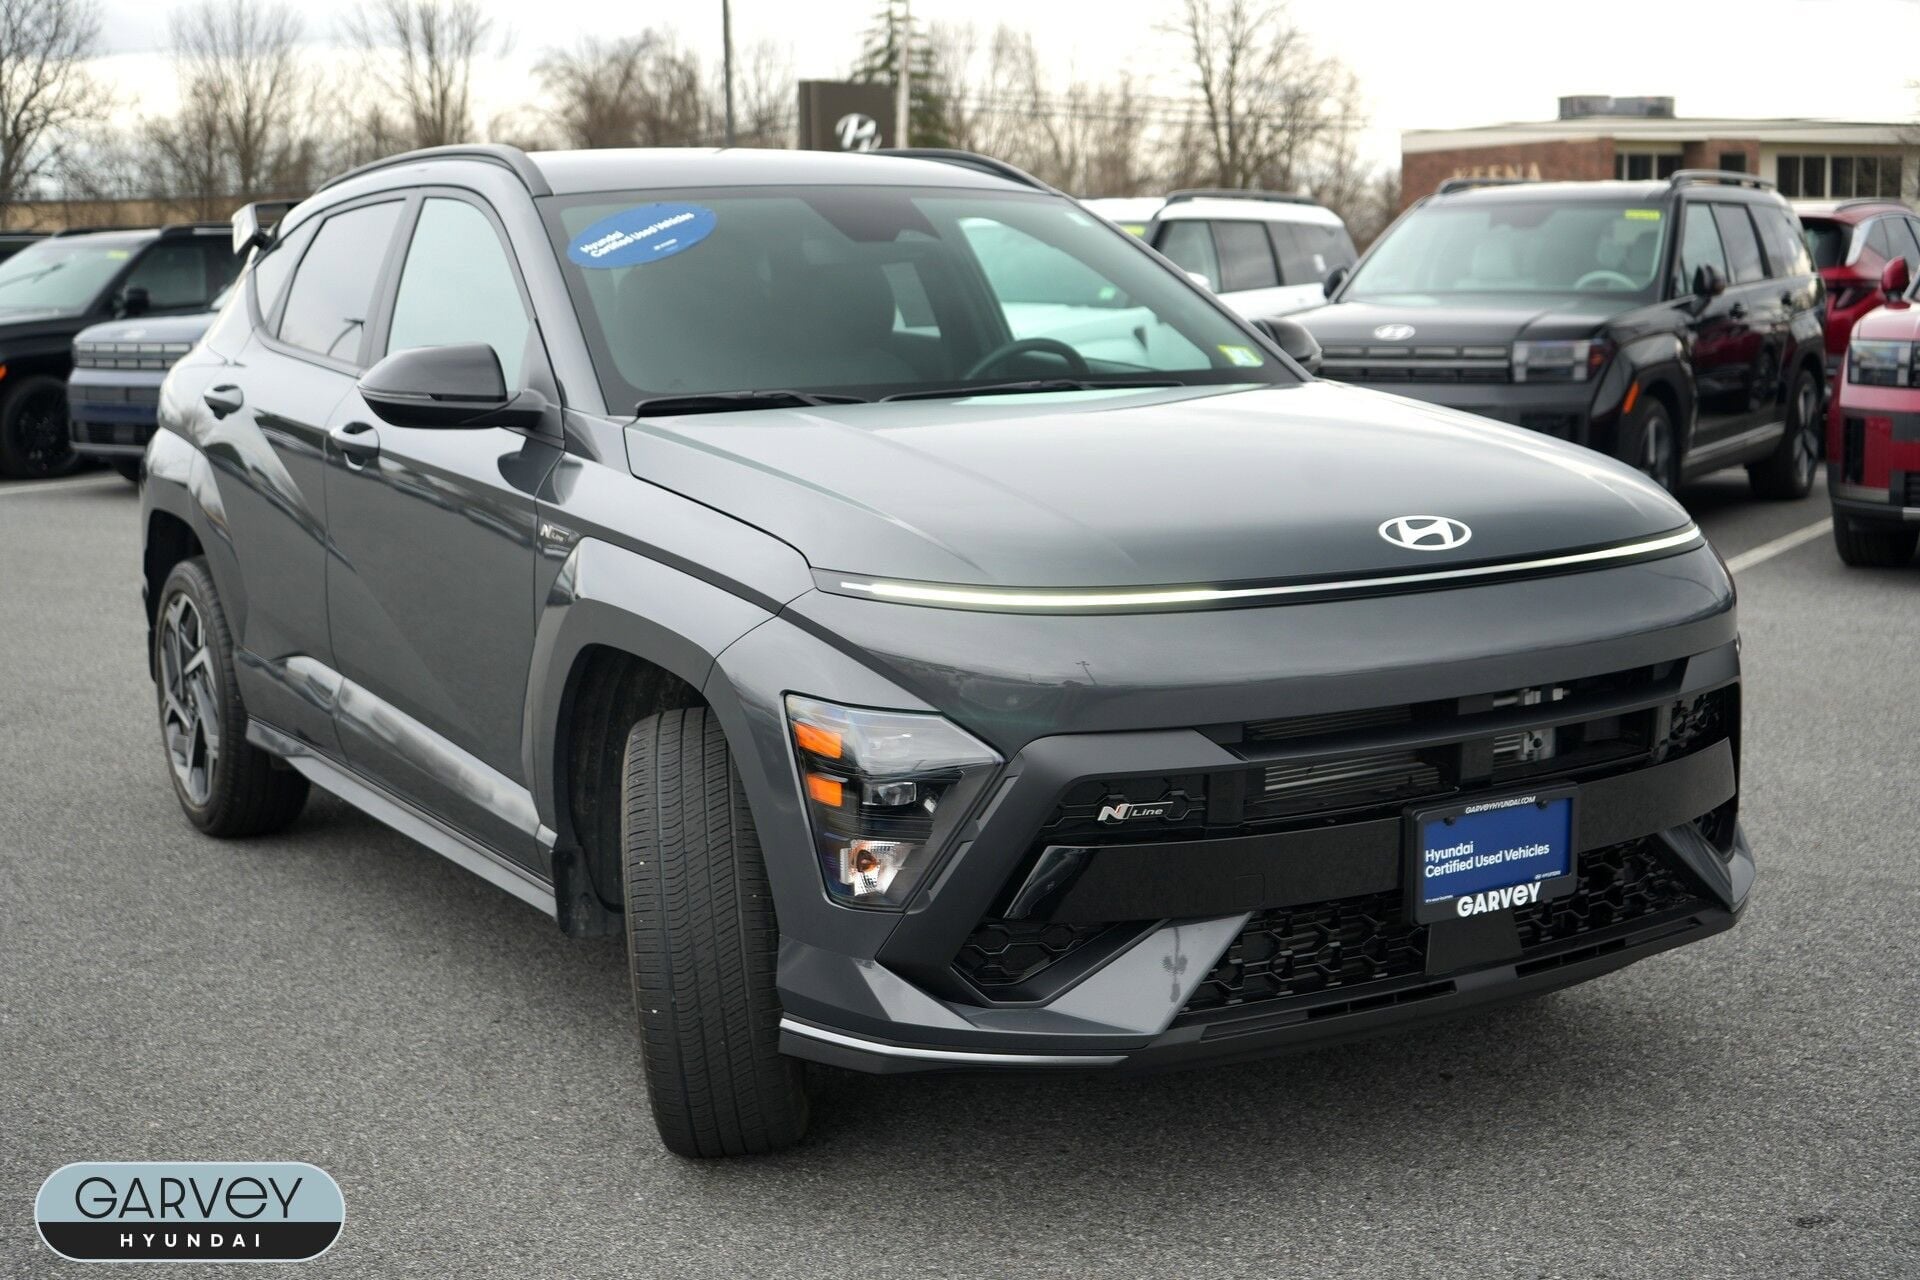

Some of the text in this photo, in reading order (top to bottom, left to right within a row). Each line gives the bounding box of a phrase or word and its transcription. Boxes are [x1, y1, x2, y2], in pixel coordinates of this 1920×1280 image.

[1098, 804, 1164, 821] N Line
[1425, 841, 1474, 863] Hyundai
[1425, 844, 1550, 878] Certified Used Vehicles
